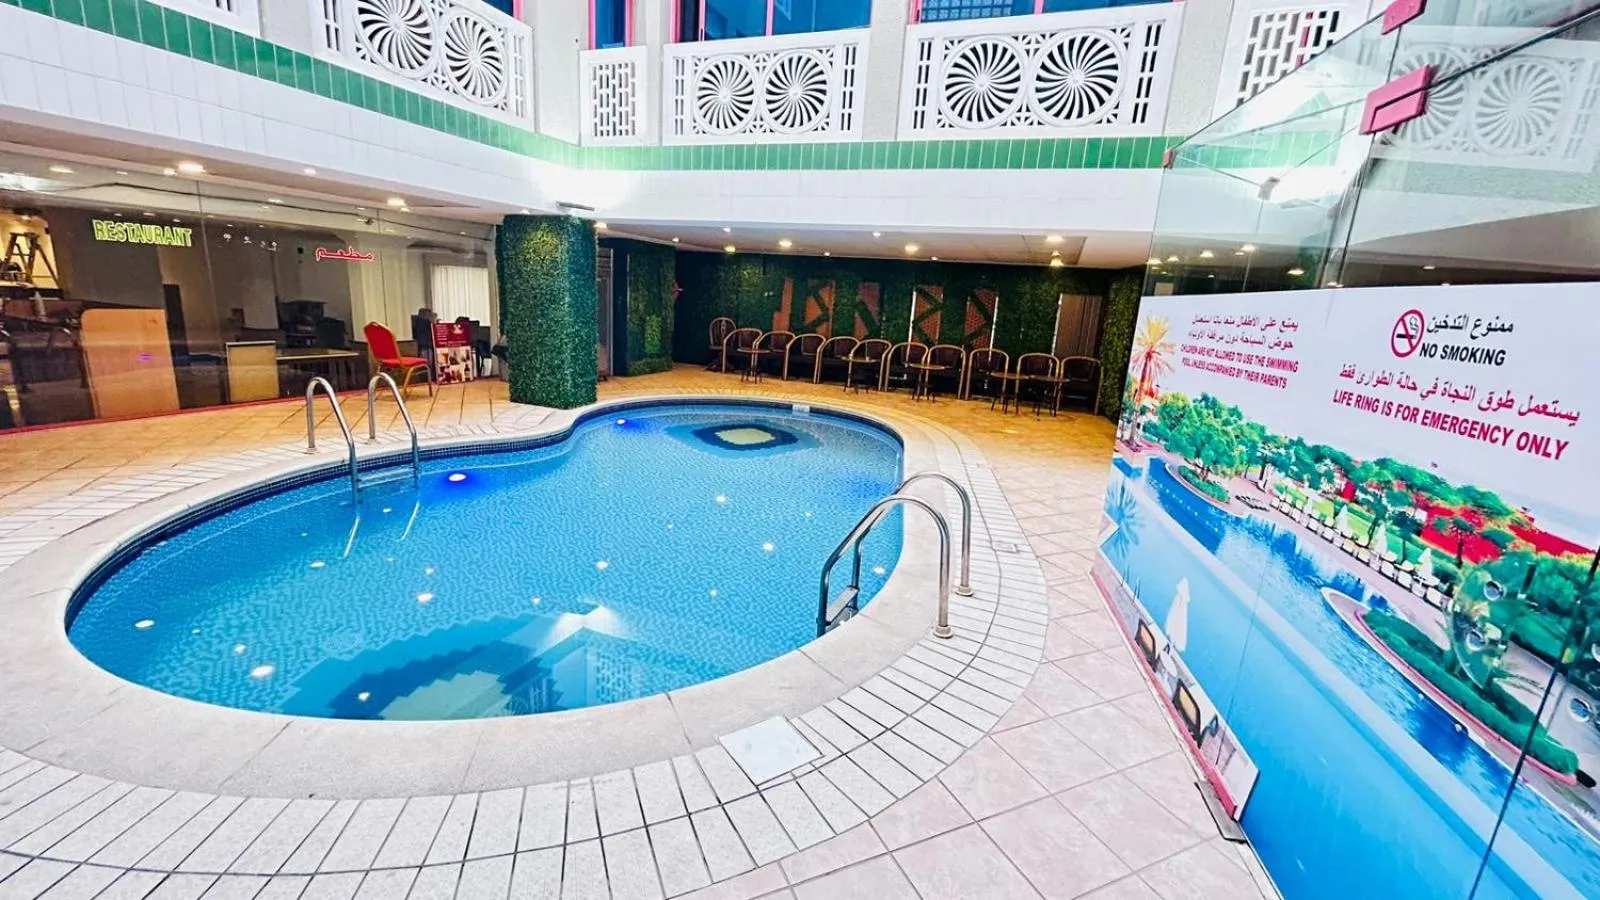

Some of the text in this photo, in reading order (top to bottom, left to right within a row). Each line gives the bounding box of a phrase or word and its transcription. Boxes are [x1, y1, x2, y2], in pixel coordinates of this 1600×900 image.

[92, 219, 192, 247] RESTAURANT
[315, 245, 374, 262] مطعم
[1427, 314, 1514, 340] ممنوع التدخين
[1268, 336, 1293, 351] حوض
[1420, 342, 1506, 366] NO SMOKING
[1236, 352, 1243, 363] TO
[1243, 353, 1254, 365] USE
[1254, 355, 1266, 367] THE
[1266, 357, 1299, 373] SWIMMING
[1339, 364, 1356, 379] فقط
[1244, 370, 1260, 382] THEIR
[1260, 373, 1288, 389] PARENTS
[1397, 371, 1418, 391] حالة
[1420, 377, 1439, 401] في
[1440, 381, 1476, 404] النجاة
[1477, 390, 1515, 412] طوق
[1518, 394, 1580, 427] يستعمل
[1333, 389, 1570, 460] LIFE RING IS FOR EMERGENCY ONLY
